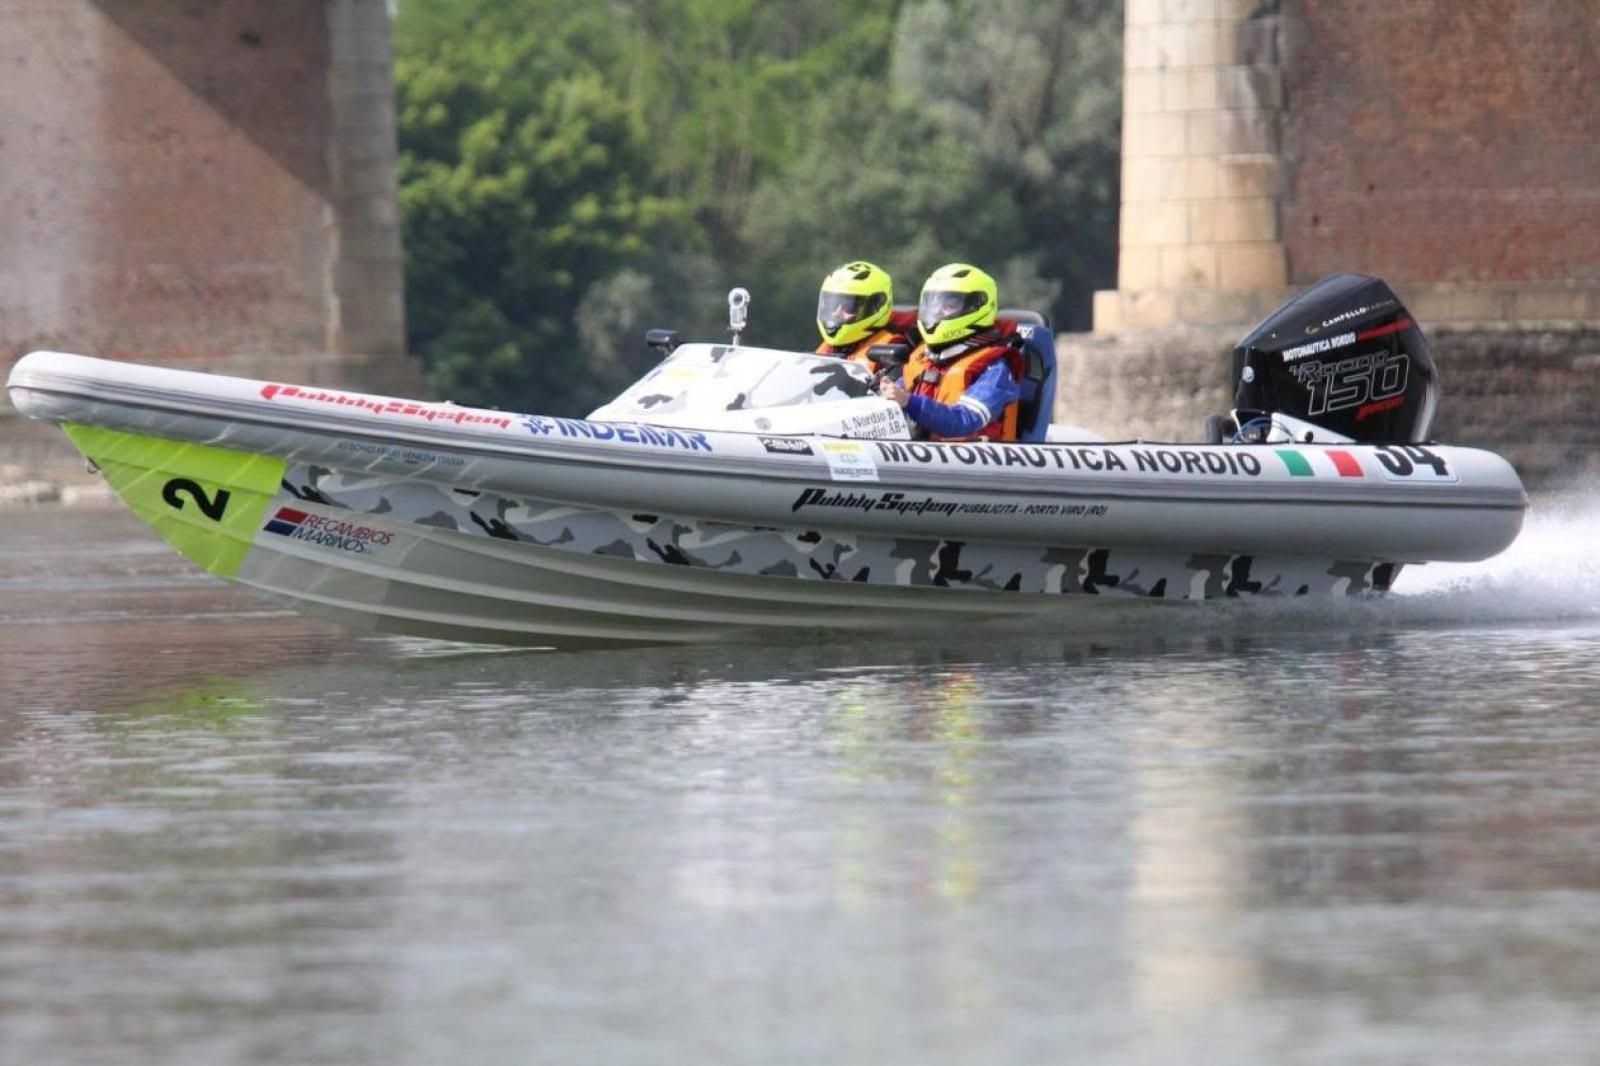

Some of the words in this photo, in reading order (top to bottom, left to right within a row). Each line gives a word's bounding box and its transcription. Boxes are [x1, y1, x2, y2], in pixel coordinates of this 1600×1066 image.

[1282, 339, 1331, 362] MOTONAUTICA
[1331, 332, 1356, 349] NORDIO
[1306, 353, 1410, 416] 150
[558, 418, 713, 452] INDEMAR
[852, 411, 886, 428] Nordio
[875, 442, 1128, 472] MOTONAUTICA
[1129, 450, 1262, 477] NORDIO
[162, 477, 231, 522] 2
[1024, 503, 1060, 516] PORTO
[1060, 504, 1086, 515] VIRO
[291, 526, 369, 553] MARINOS
[304, 514, 396, 546] RECAMBIOS
